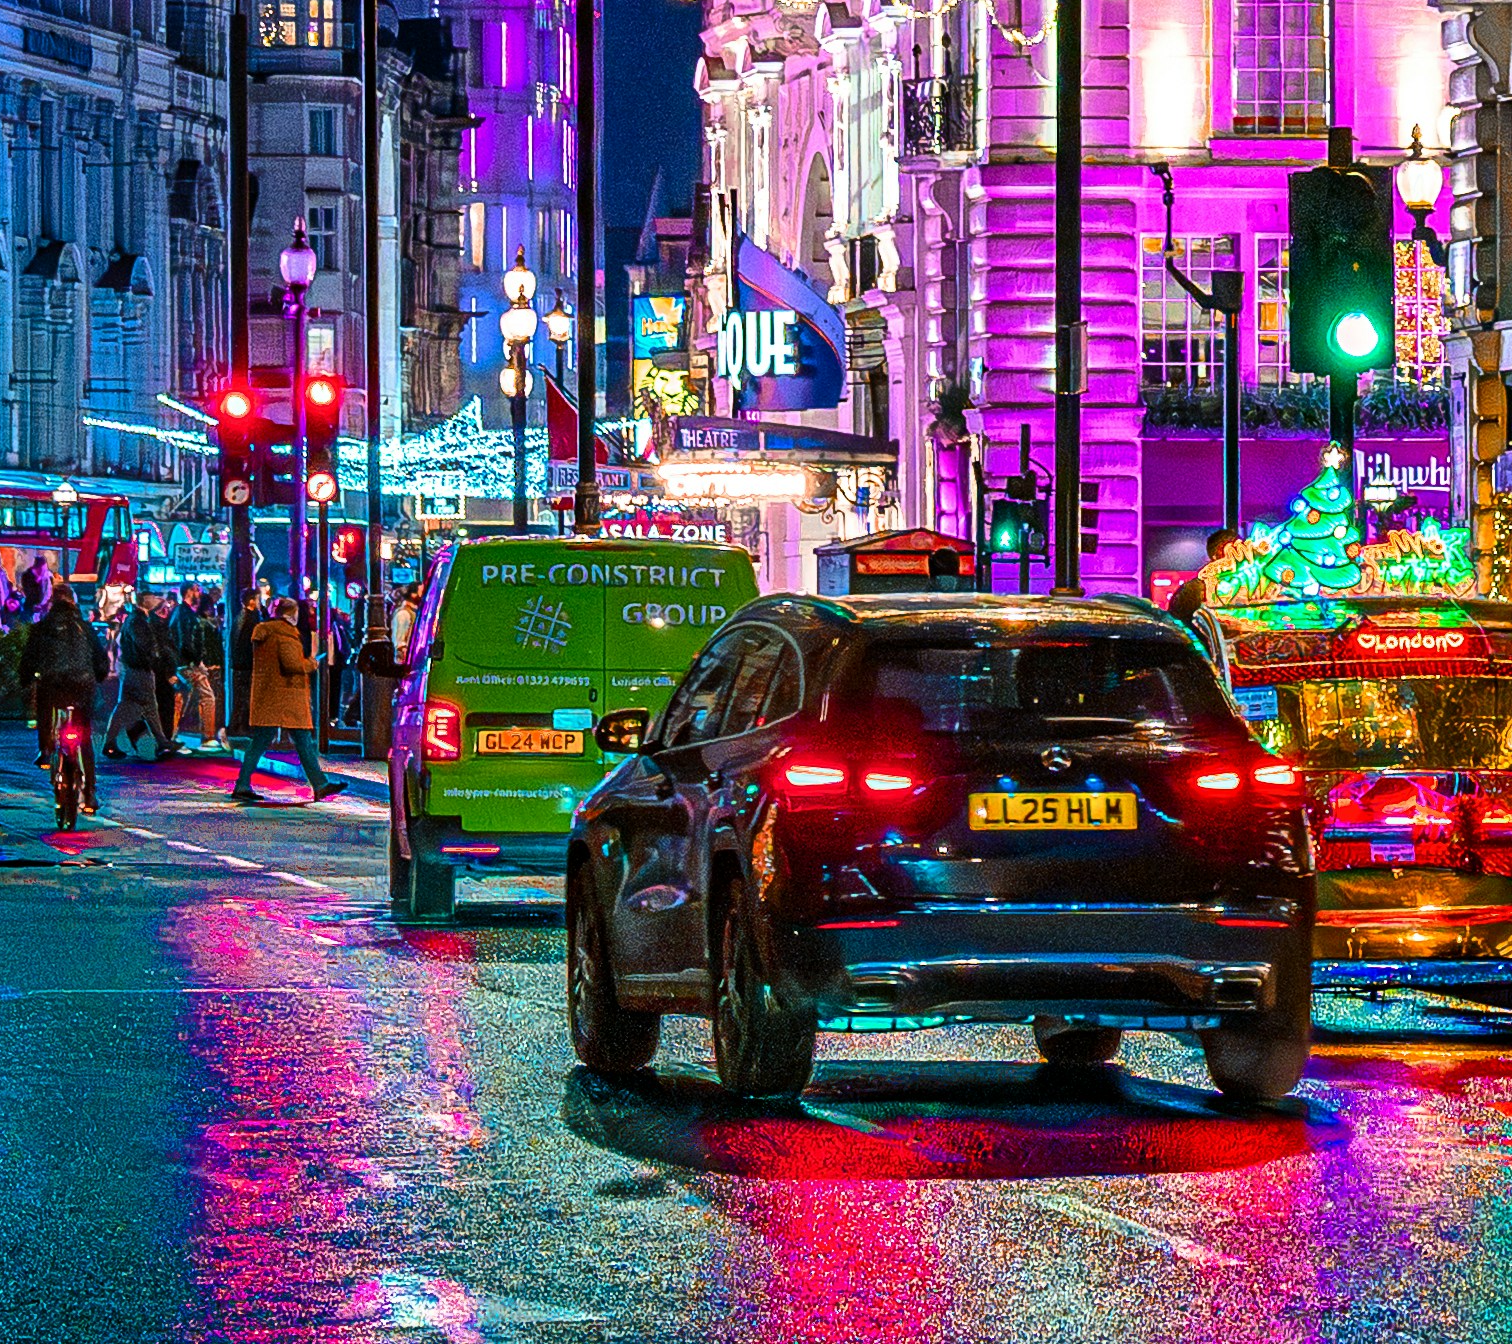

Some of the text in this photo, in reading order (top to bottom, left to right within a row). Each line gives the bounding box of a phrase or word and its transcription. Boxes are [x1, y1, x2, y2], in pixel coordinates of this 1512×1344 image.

[680, 428, 738, 449] THEATRE
[671, 525, 726, 542] ZONE
[482, 563, 726, 589] PRE-CONSTRUCT
[622, 603, 727, 626] GROUP
[1374, 632, 1447, 652] London
[485, 733, 533, 750] GL24
